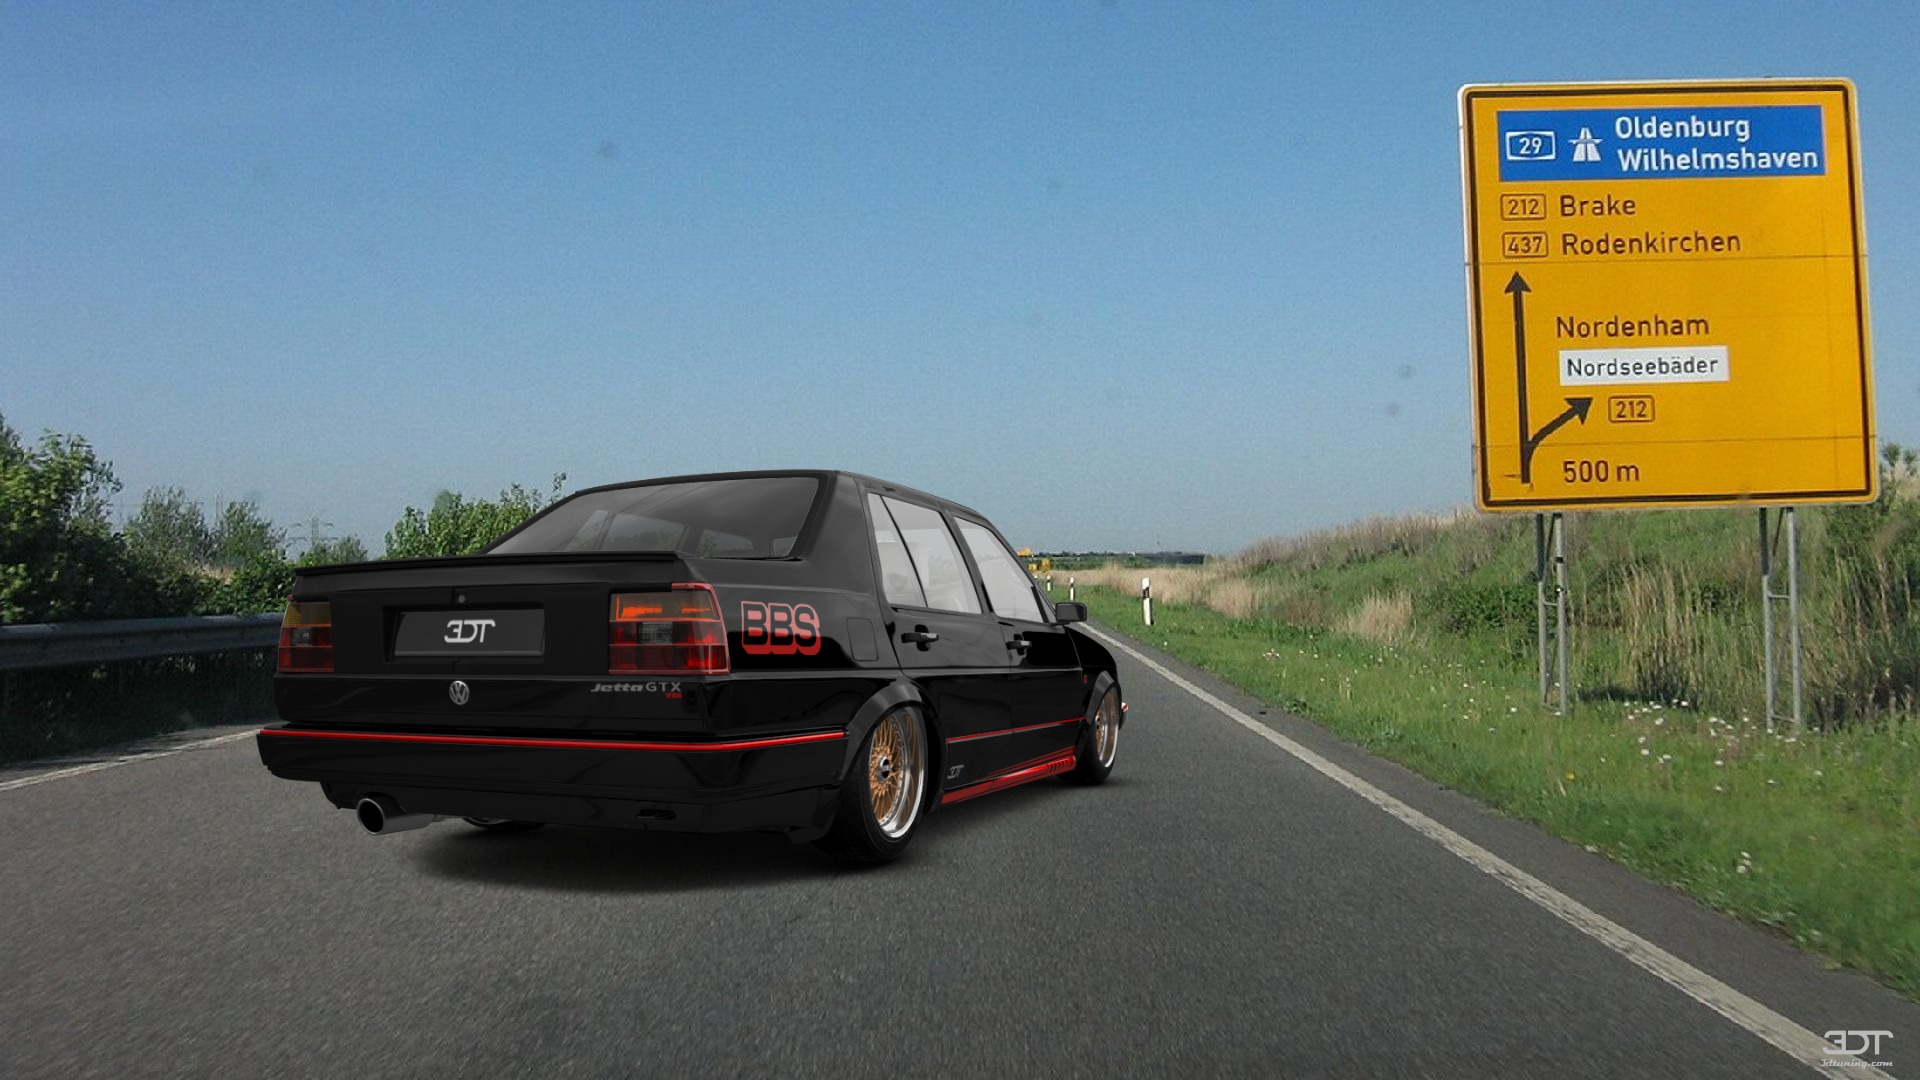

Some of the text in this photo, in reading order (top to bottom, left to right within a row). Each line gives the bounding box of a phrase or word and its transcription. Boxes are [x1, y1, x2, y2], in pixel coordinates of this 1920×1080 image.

[1615, 116, 1750, 141] Oldenburg
[1519, 137, 1542, 155] 29
[1618, 147, 1819, 172] Wilhelmshaven
[1507, 199, 1539, 216] 212
[1560, 196, 1636, 217] Brake
[1508, 235, 1542, 254] 437
[1562, 232, 1740, 256] Rodenkirchen
[1557, 315, 1709, 338] Nordenham
[1567, 356, 1719, 377] Nordseebäder
[1615, 400, 1648, 419] 212
[1563, 460, 1639, 483] 500 m
[444, 619, 496, 643] 3DT
[741, 601, 821, 655] BBS
